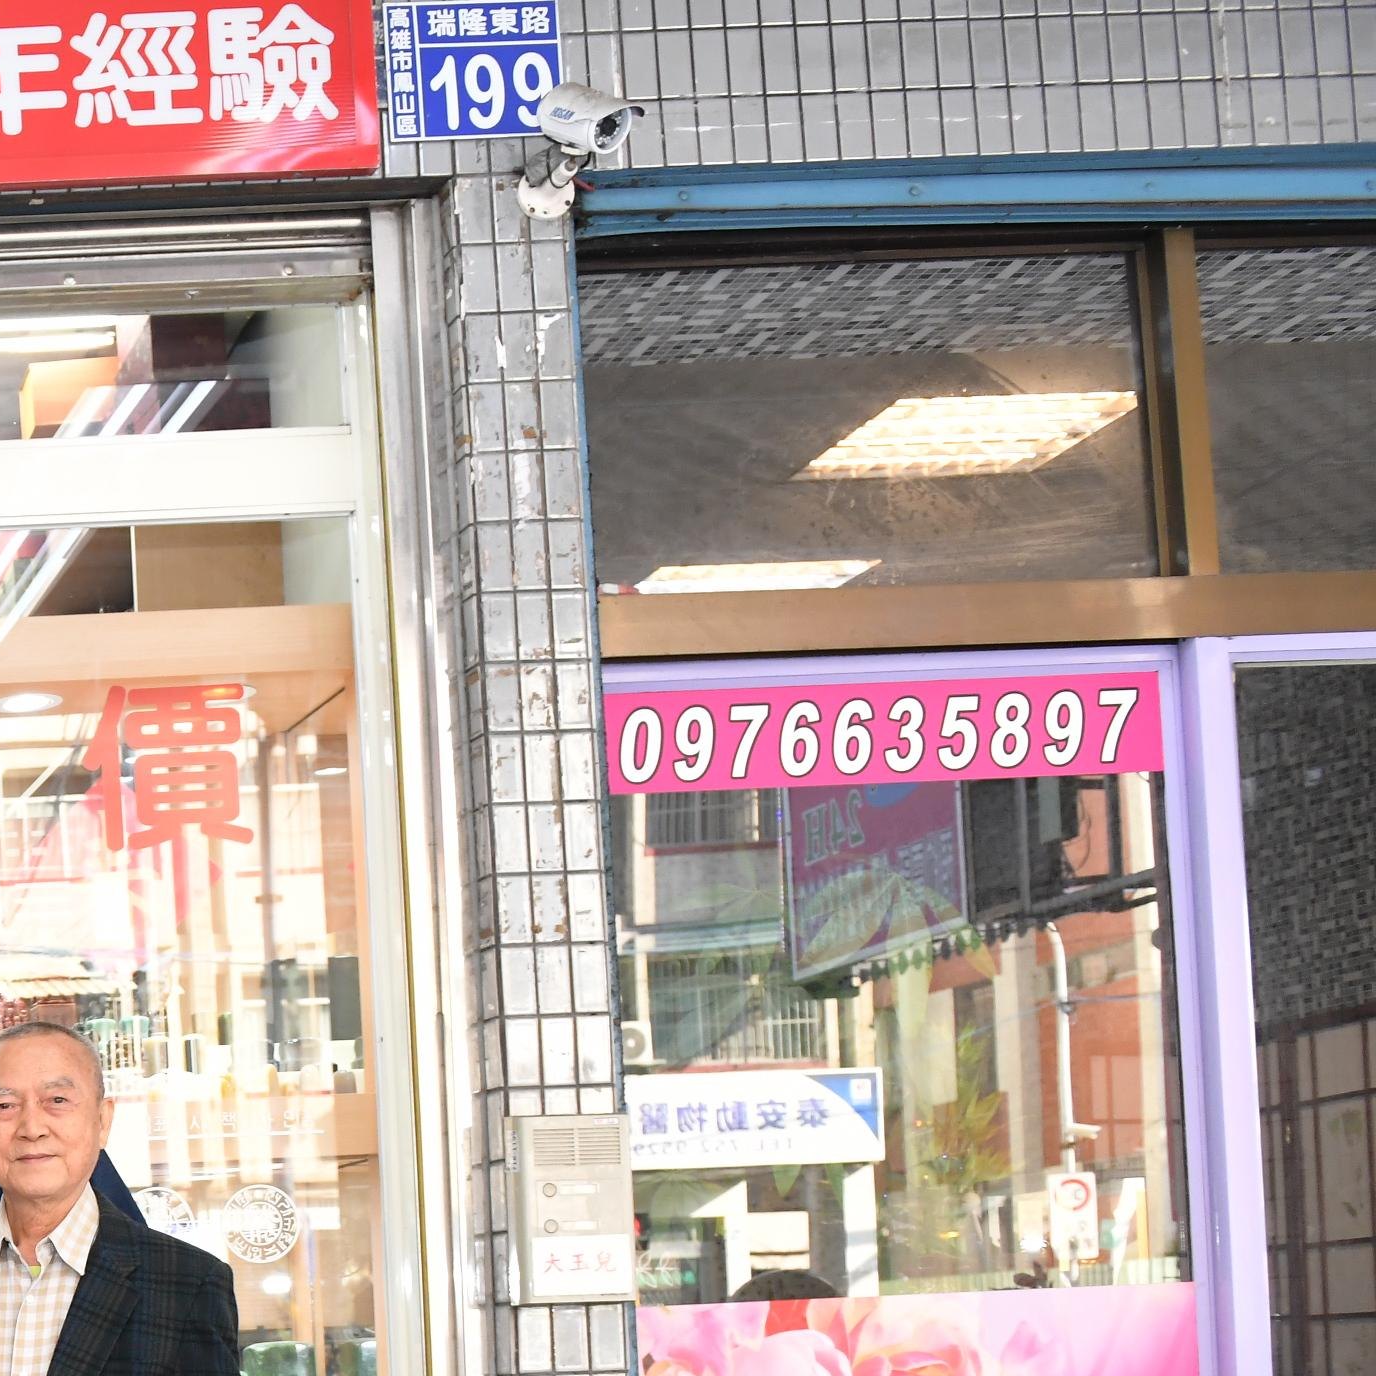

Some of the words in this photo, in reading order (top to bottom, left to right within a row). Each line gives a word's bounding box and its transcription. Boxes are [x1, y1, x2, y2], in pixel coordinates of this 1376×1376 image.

[427, 6, 551, 38] 瑞隆東路
[388, 7, 418, 137] 高雄市鳳山區
[430, 52, 554, 131] 199
[618, 688, 1141, 784] 0976635897
